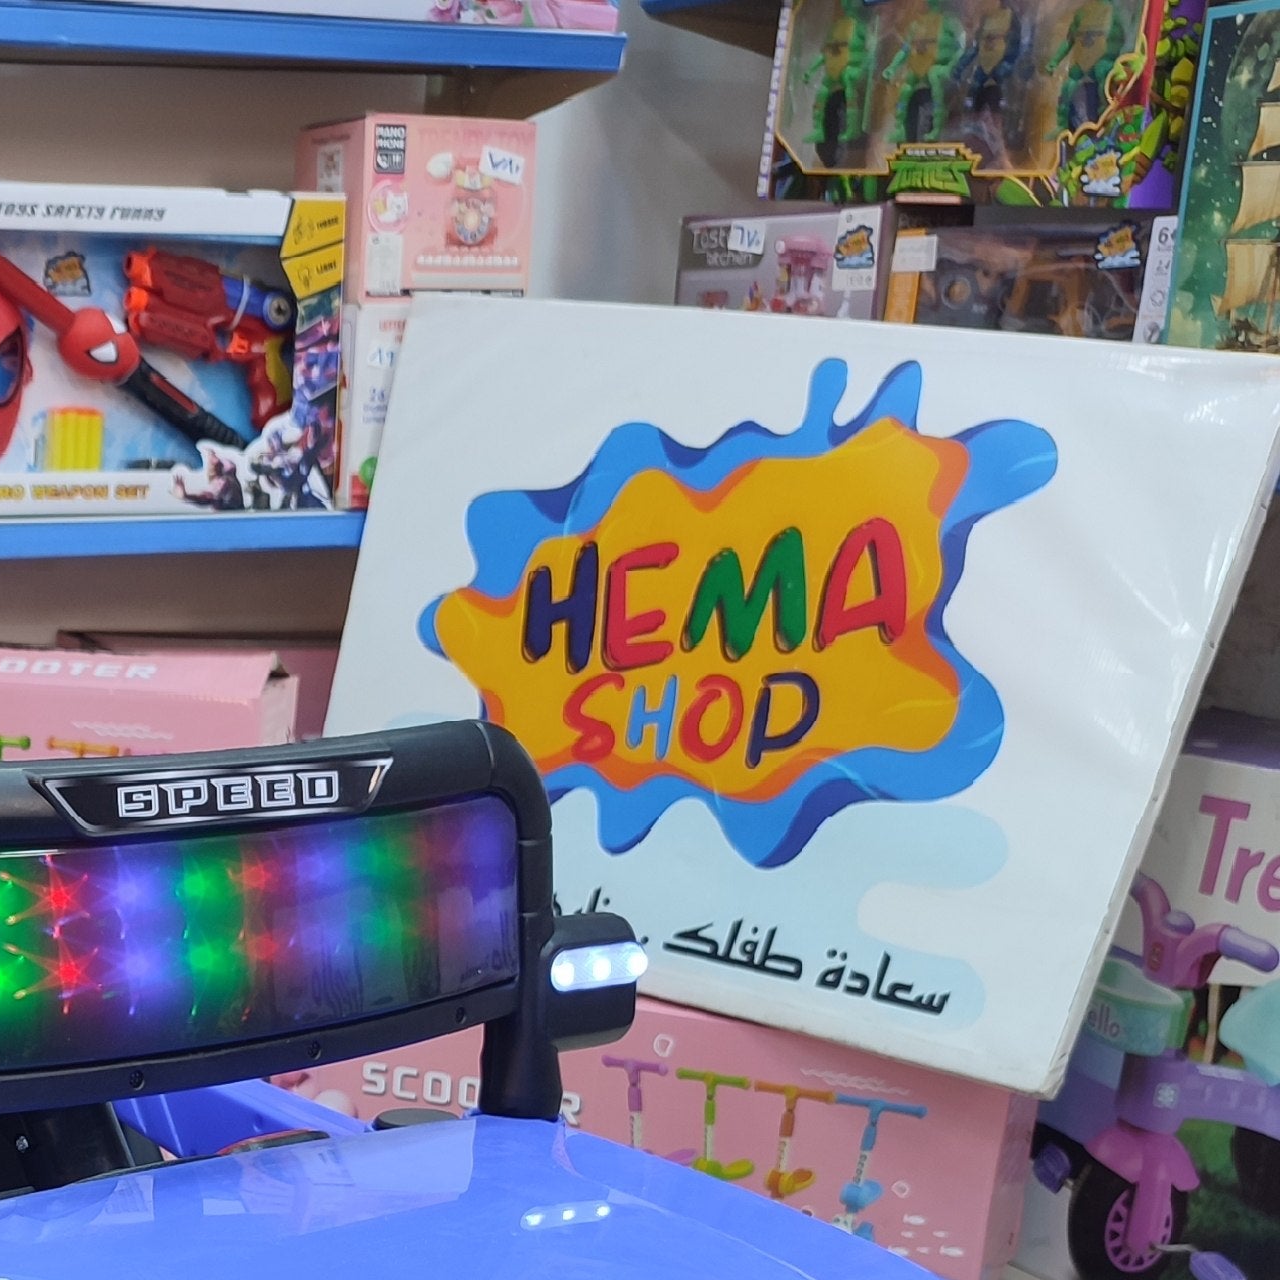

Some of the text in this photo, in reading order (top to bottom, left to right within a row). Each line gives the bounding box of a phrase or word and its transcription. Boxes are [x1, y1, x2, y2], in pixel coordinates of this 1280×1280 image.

[520, 517, 908, 675] HEMA
[562, 671, 821, 770] SHOP
[117, 769, 340, 818] SPEED
[661, 917, 951, 1017] سعادة طفلك
[1087, 1001, 1122, 1038] ello
[361, 1060, 582, 1127] SCOOR
